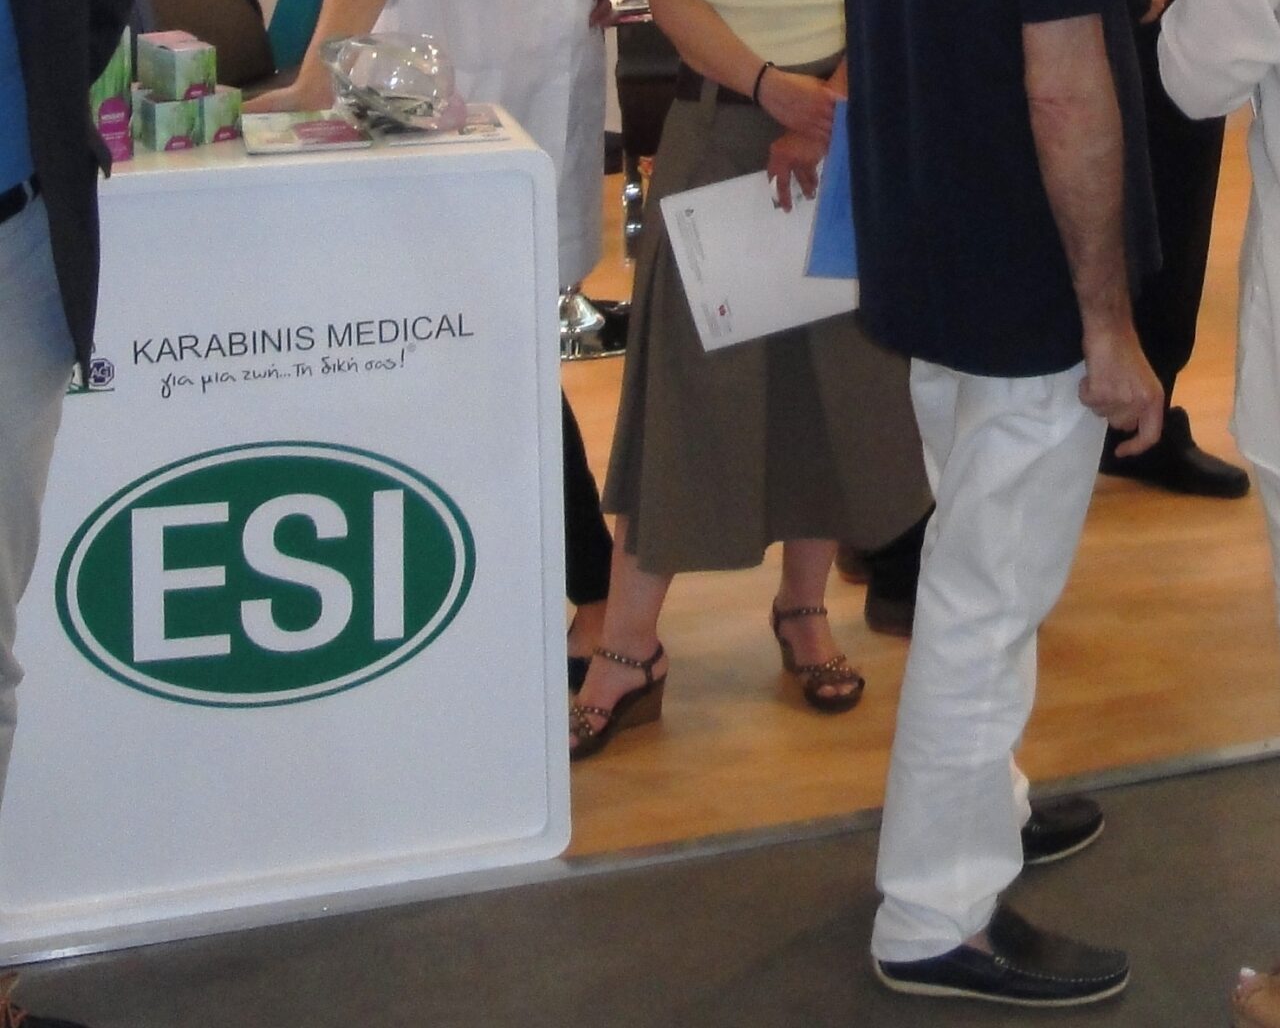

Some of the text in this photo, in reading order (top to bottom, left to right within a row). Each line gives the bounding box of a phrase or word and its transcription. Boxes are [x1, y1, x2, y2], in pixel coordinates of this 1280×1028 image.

[133, 313, 474, 365] KARABINIS MEDICAL
[162, 372, 193, 399] για
[201, 372, 236, 394] μια
[321, 357, 358, 375] δική
[131, 489, 404, 663] ESI
